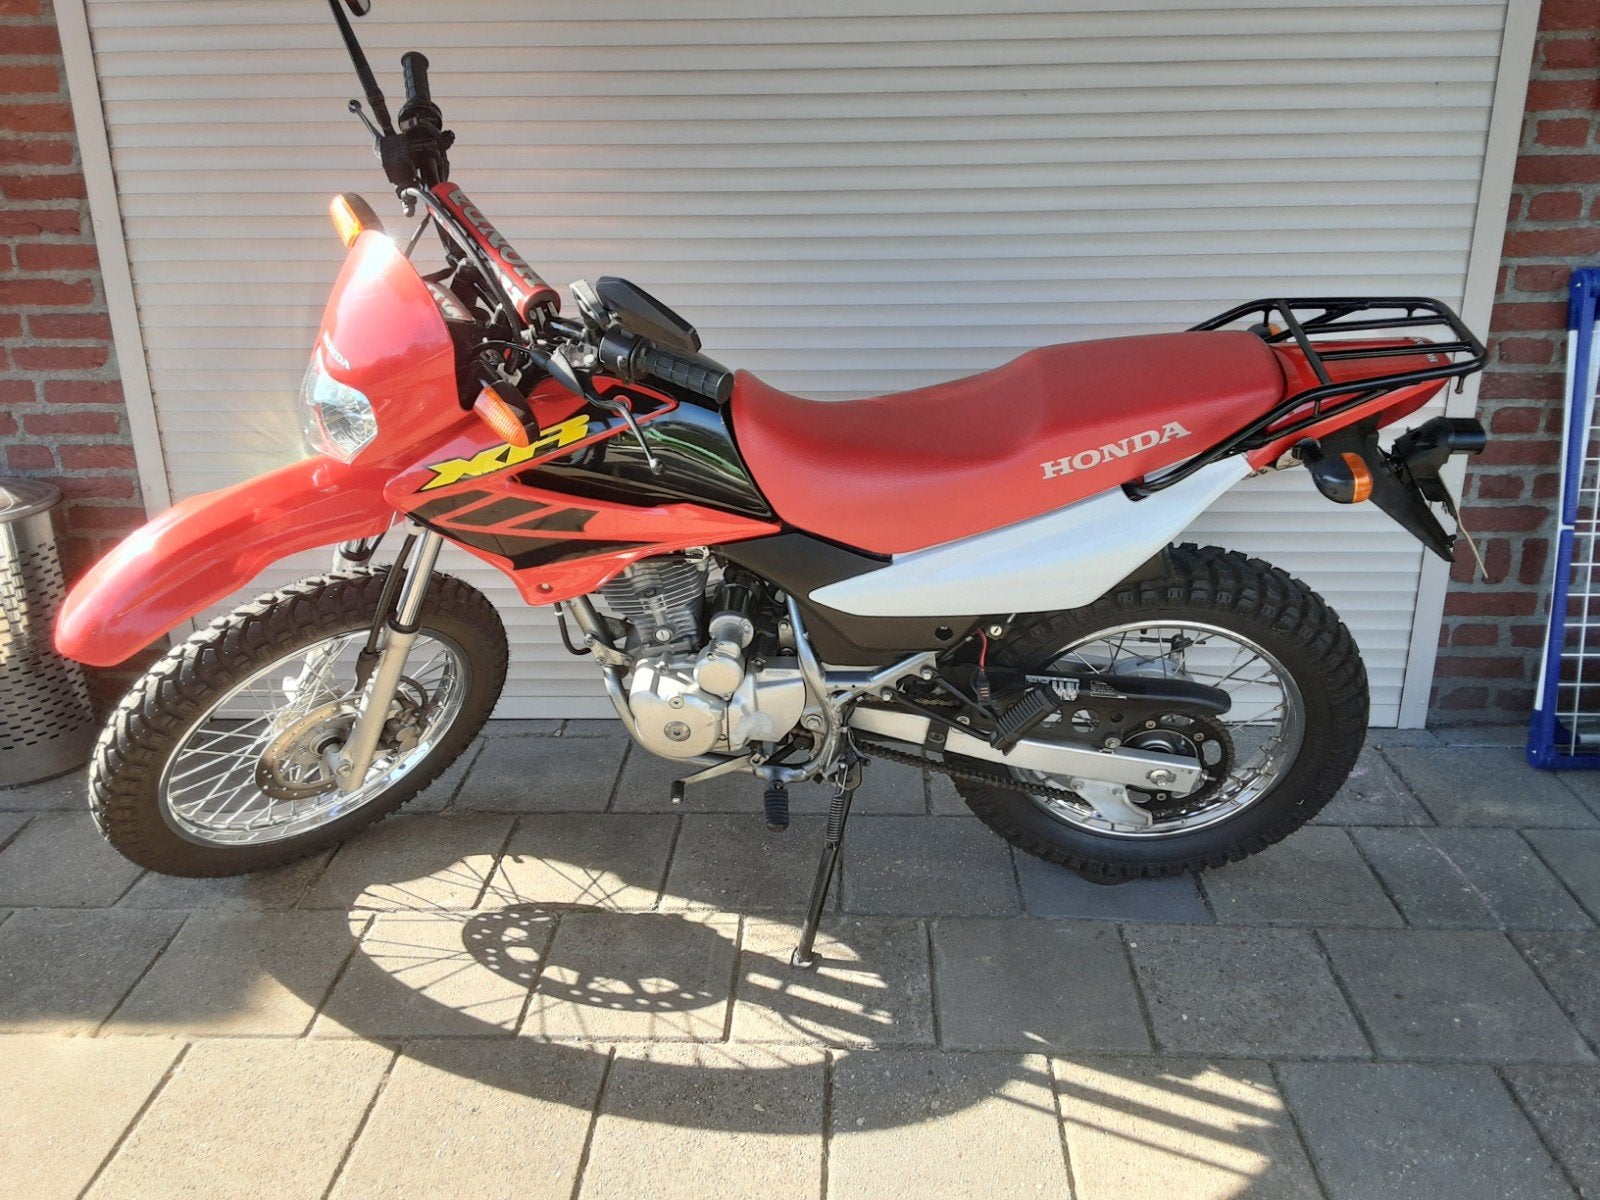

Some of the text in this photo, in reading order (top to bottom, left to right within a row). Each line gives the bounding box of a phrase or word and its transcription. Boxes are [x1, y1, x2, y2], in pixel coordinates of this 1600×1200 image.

[448, 190, 548, 288] HONDA
[417, 414, 590, 492] XR
[1040, 421, 1192, 480] HONDA
